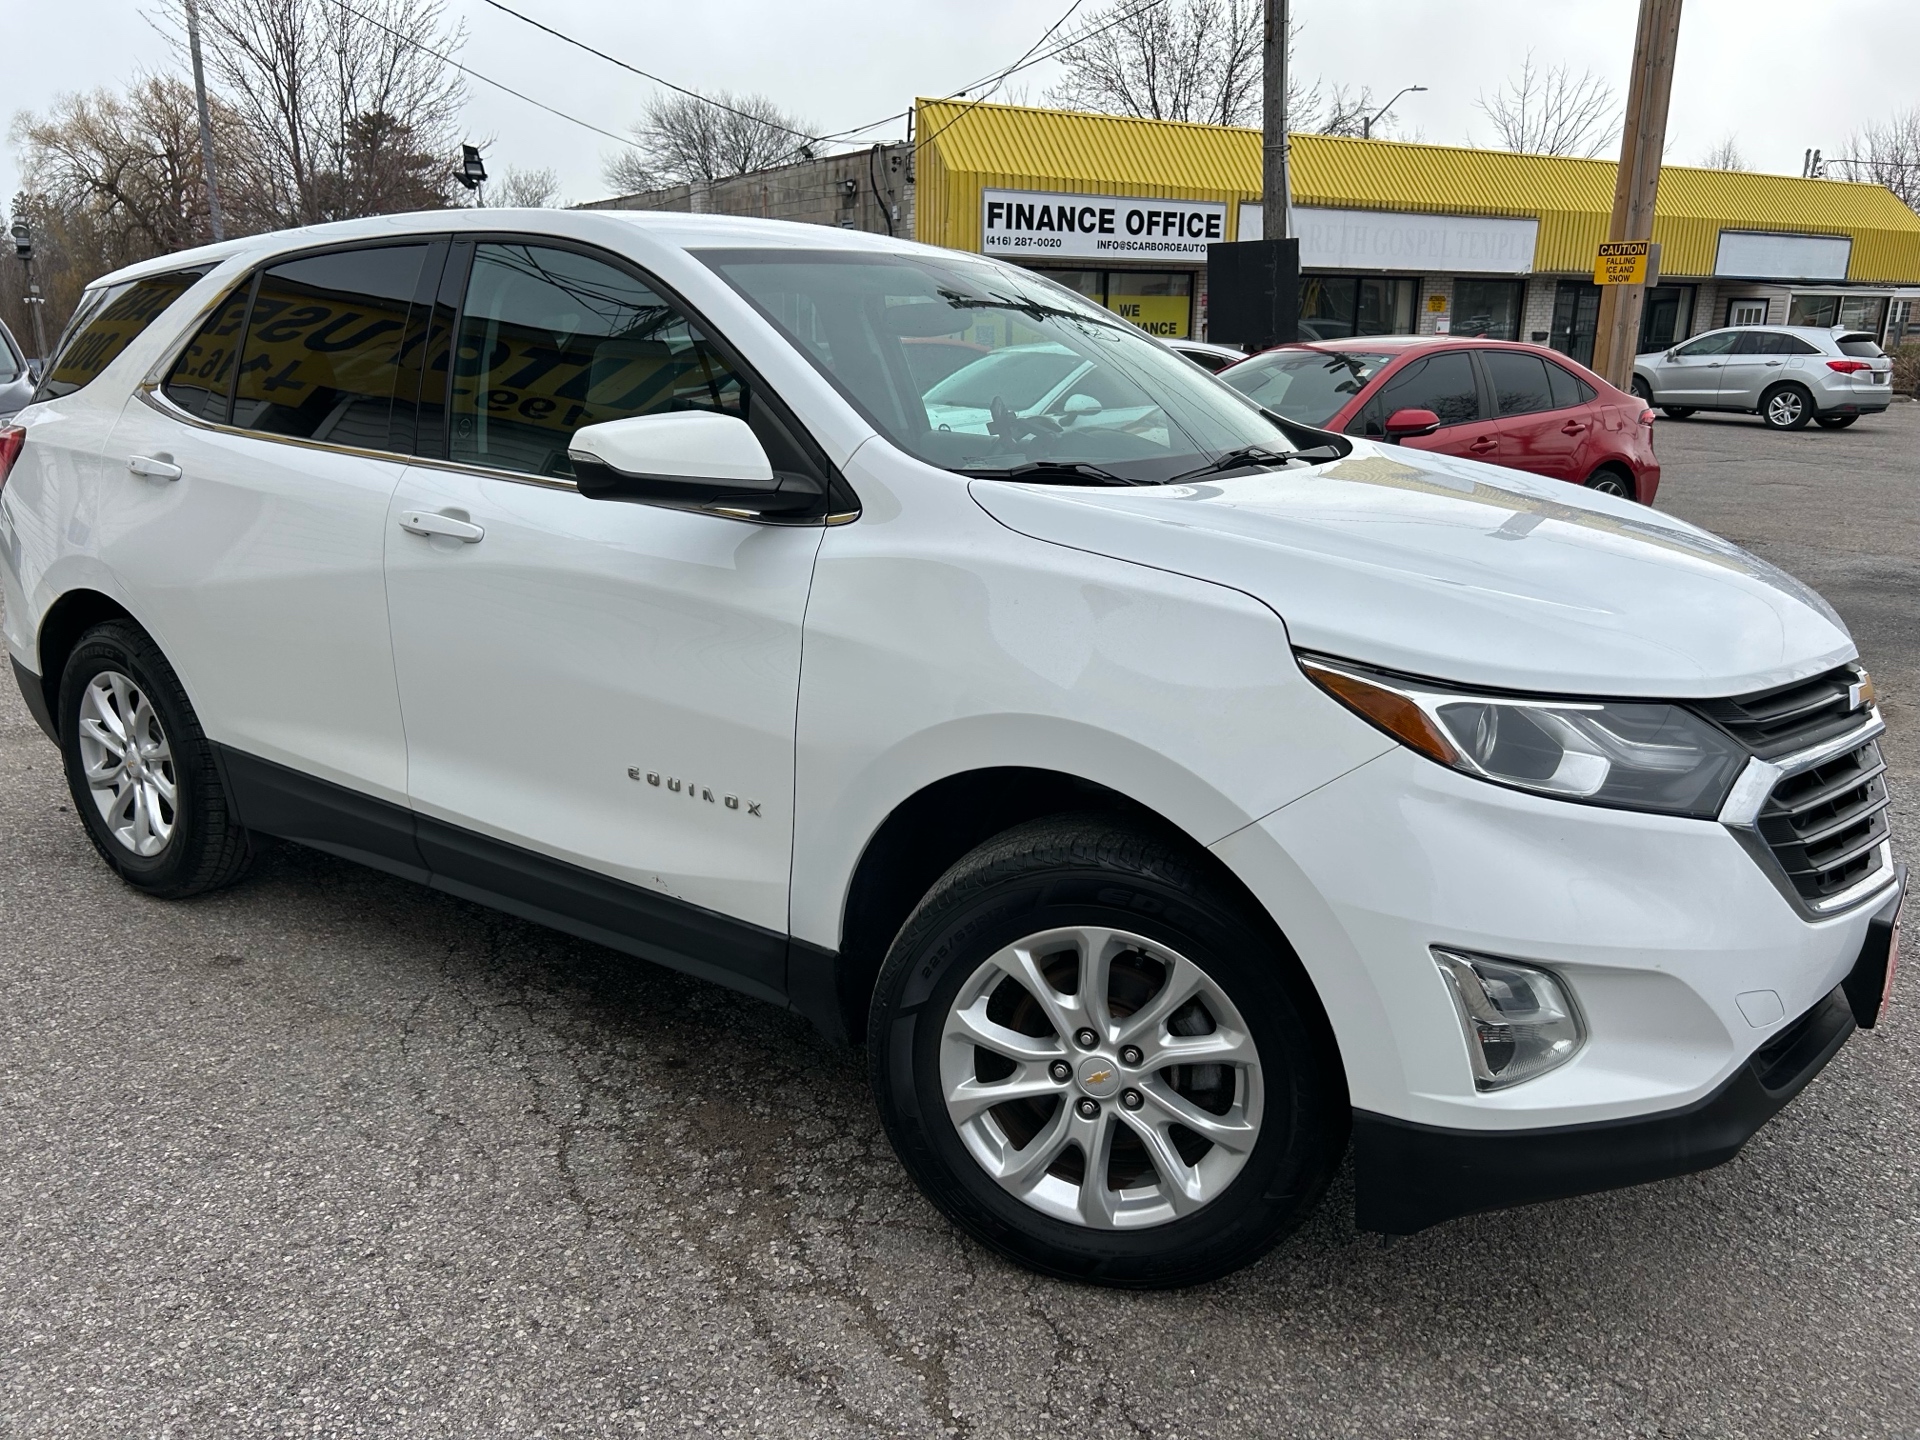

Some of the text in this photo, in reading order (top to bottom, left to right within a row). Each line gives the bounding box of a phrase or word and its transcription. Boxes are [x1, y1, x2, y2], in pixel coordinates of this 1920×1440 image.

[987, 202, 1221, 238] FINANCE OFFICE
[986, 235, 1062, 248] (416) 287-0020
[1600, 244, 1645, 256] CAUTION
[1606, 257, 1636, 265] FALLING
[1608, 274, 1630, 282] SNOW
[1119, 304, 1140, 317] WE
[627, 765, 761, 817] EQUINOX
